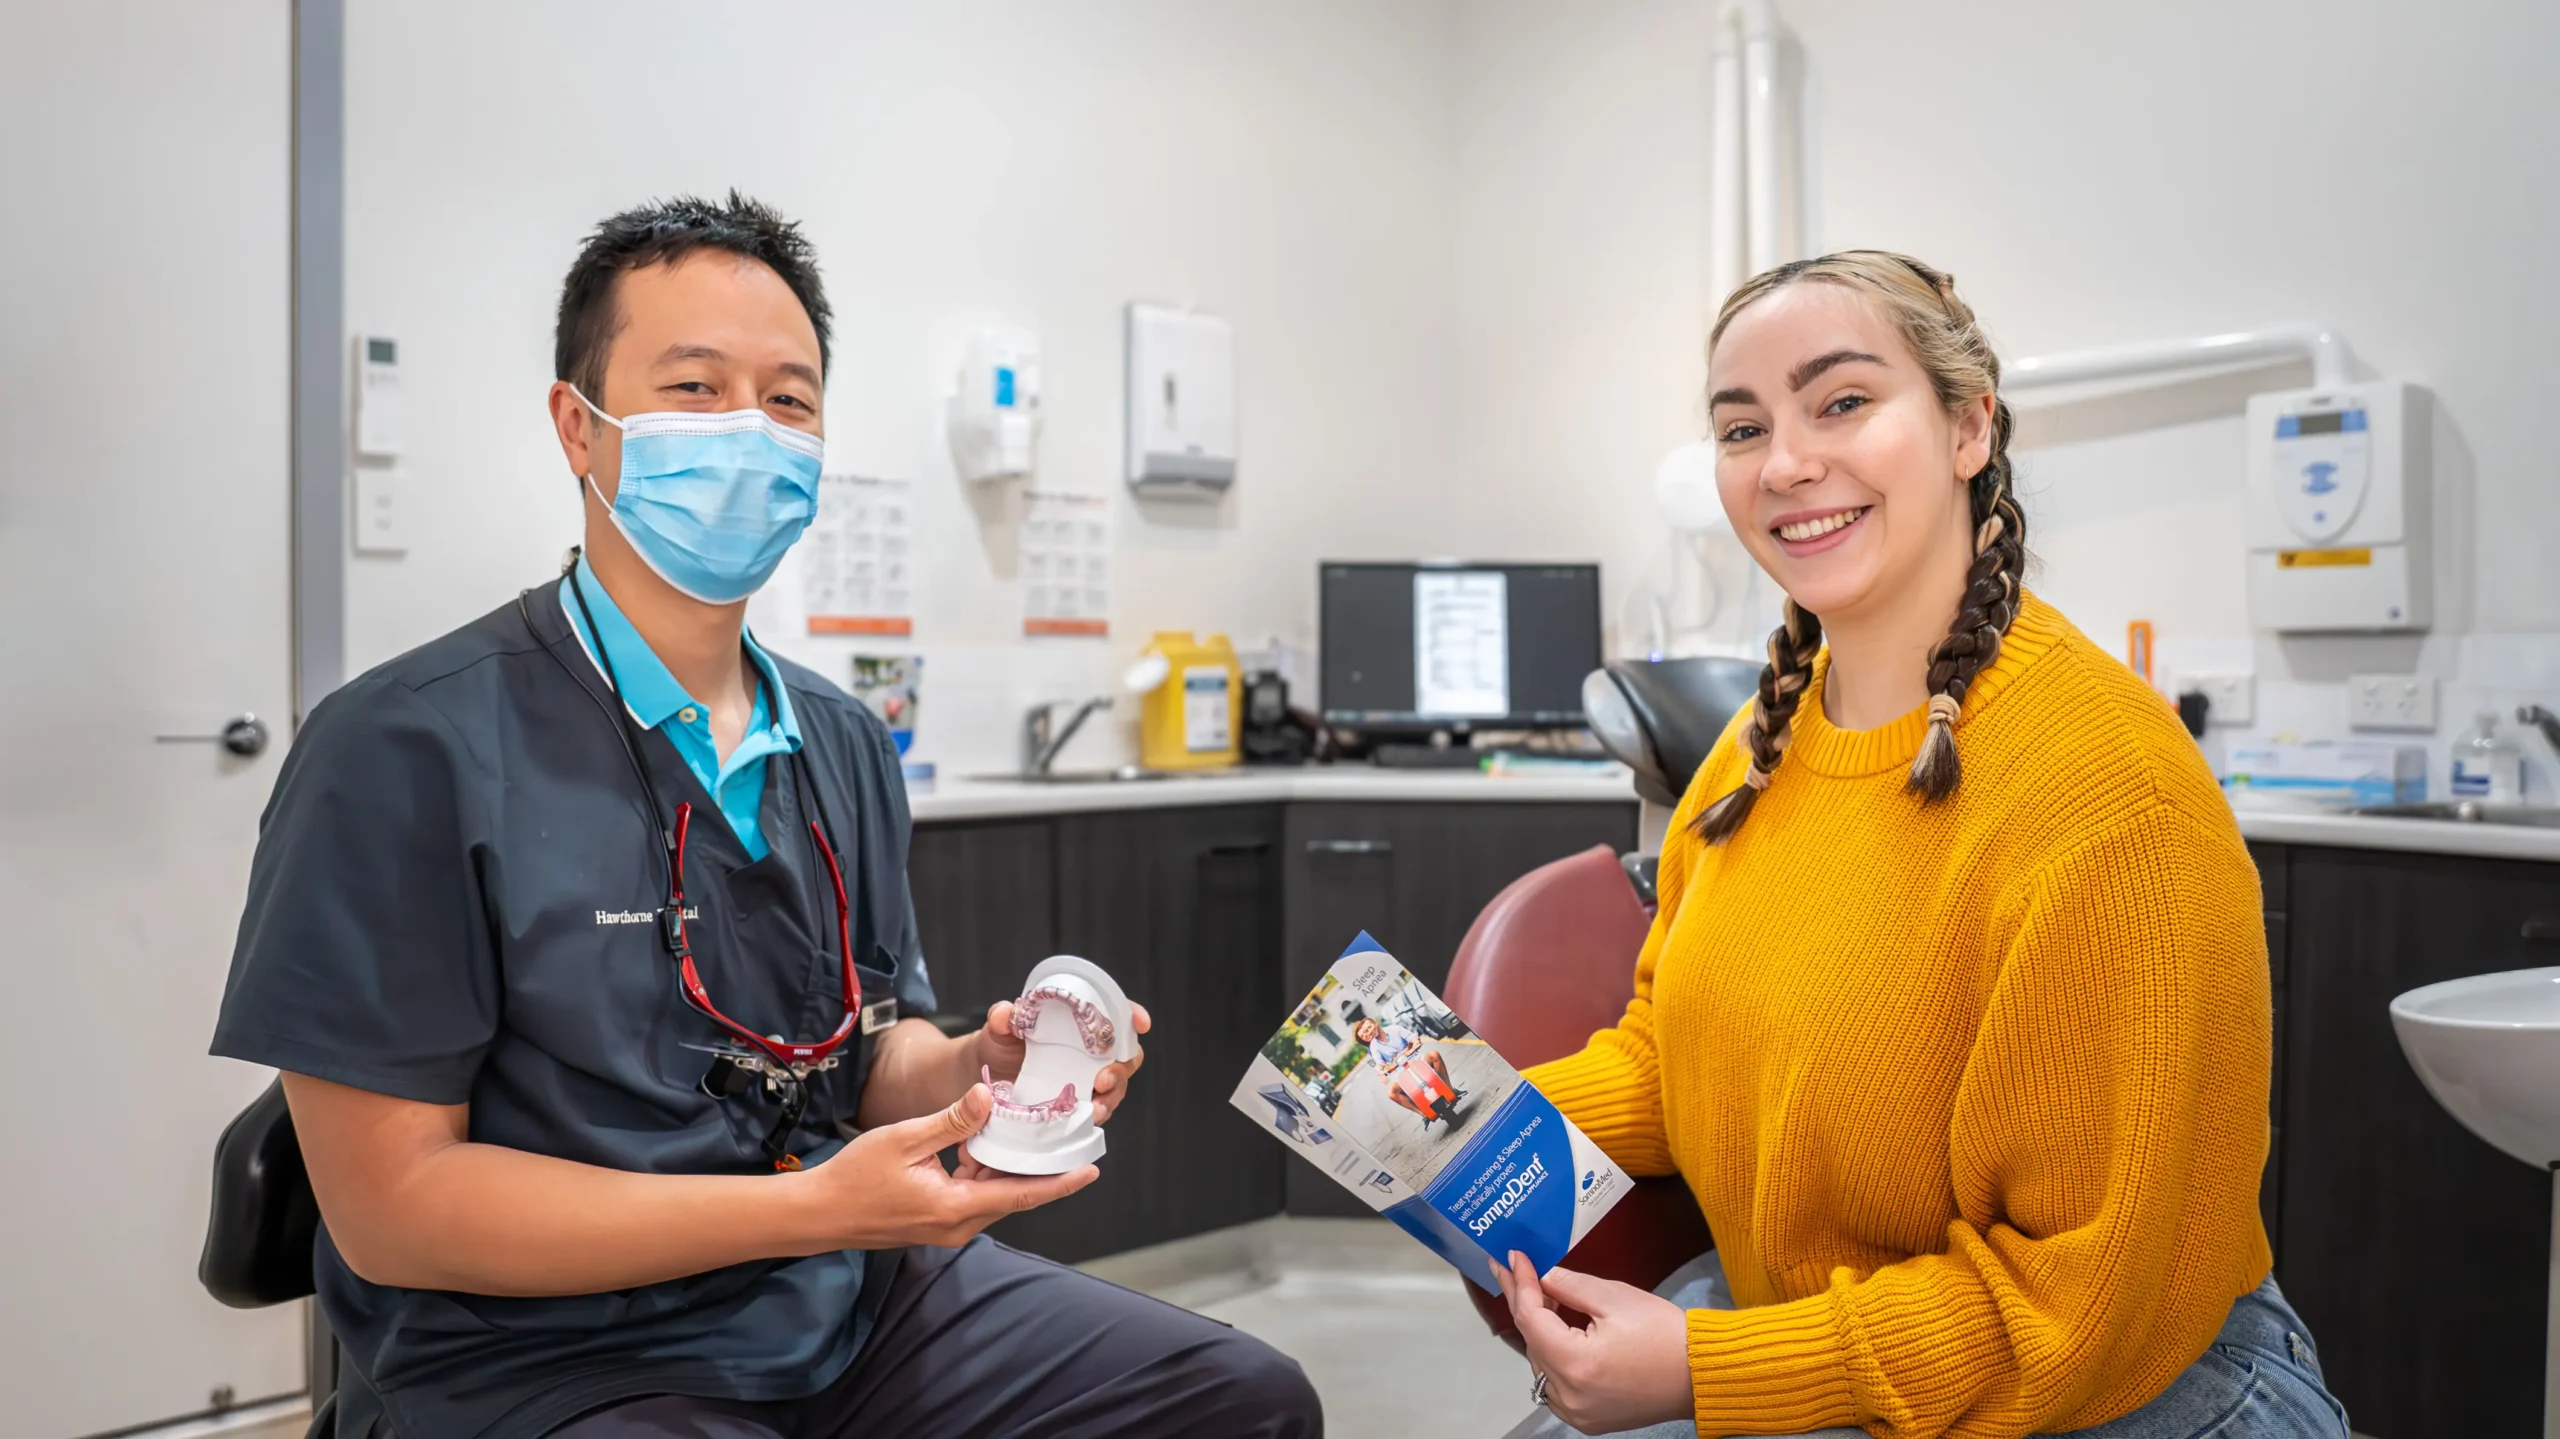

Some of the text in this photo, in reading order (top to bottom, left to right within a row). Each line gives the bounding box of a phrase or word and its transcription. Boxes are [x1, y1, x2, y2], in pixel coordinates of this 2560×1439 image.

[595, 910, 653, 924] Hawthorne
[1352, 966, 1375, 990] Sleep
[1361, 970, 1387, 998] Apnea
[1447, 1116, 1542, 1213] Treat your Snoring & Sleep Apnea
[1458, 1162, 1517, 1222] with clinically proven
[1503, 1170, 1549, 1219] SLEEP APNEA APPLIANCE
[1578, 1167, 1613, 1206] SomnoMed
